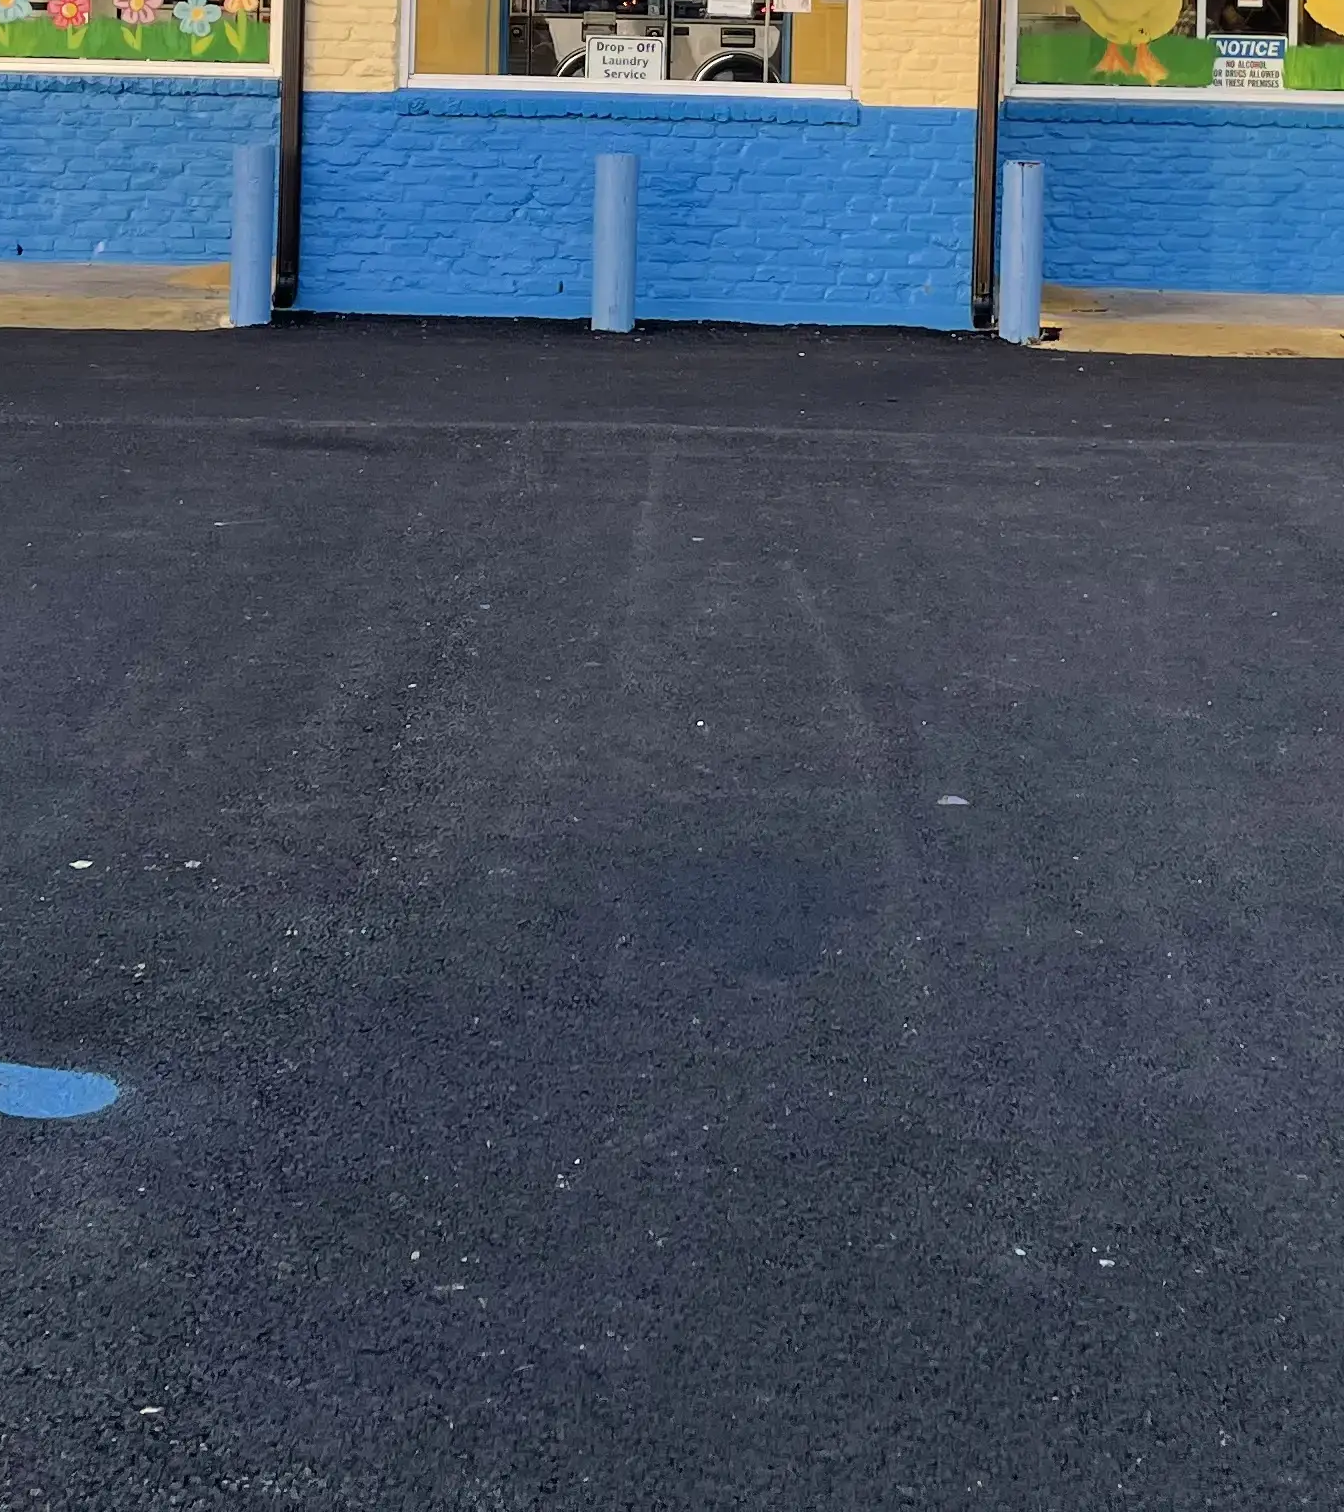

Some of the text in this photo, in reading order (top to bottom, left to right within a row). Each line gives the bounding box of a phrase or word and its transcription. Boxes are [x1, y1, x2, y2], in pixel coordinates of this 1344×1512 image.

[596, 41, 625, 54] Drop
[636, 43, 656, 53] Off
[1216, 40, 1280, 57] NOTICE
[602, 56, 649, 68] Laundry
[1225, 60, 1236, 68] NO
[603, 69, 647, 80] Service
[1249, 70, 1280, 79] ALLOWED
